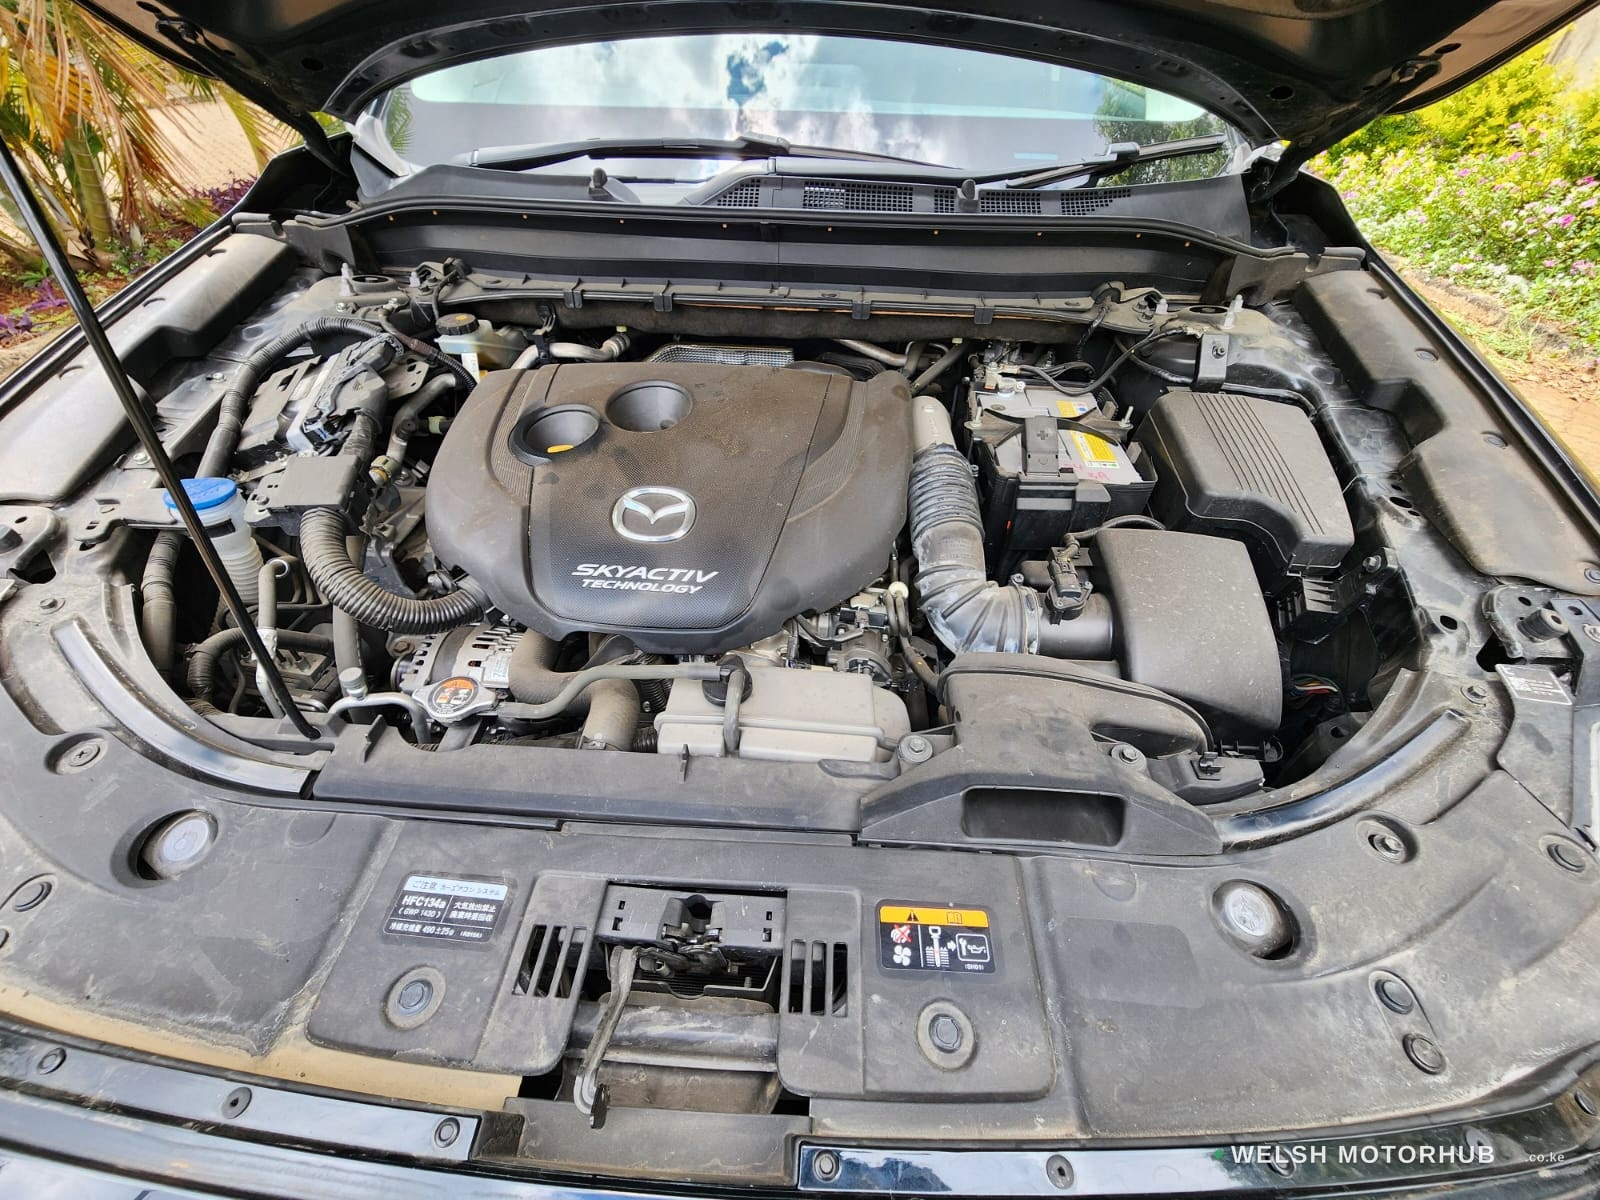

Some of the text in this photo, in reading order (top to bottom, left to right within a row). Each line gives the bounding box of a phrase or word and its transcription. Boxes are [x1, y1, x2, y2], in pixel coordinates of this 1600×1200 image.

[571, 563, 719, 583] SKYACTIV
[581, 579, 703, 594] TECHNOLOGY
[402, 895, 446, 909] HFC134a
